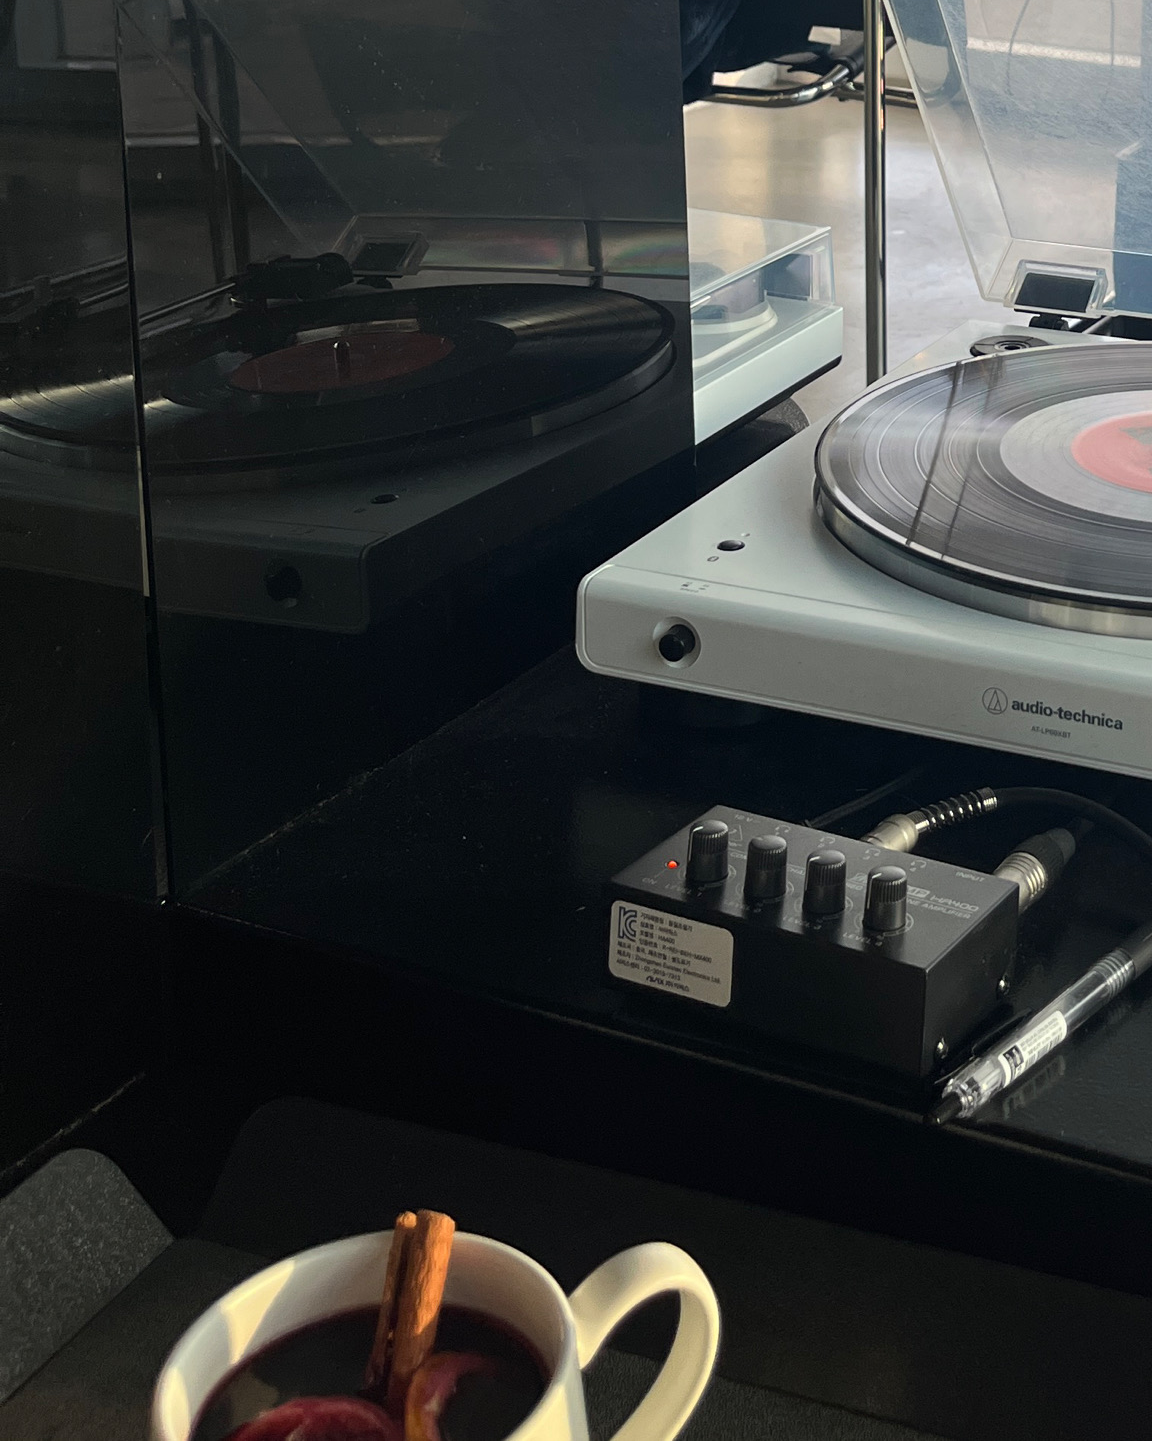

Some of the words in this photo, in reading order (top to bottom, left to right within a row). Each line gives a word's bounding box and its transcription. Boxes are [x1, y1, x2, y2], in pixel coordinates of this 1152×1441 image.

[1011, 700, 1123, 731] audio-technica
[955, 871, 985, 883] INPUT
[921, 903, 972, 920] AMPLIFIER
[929, 895, 979, 912] HA400
